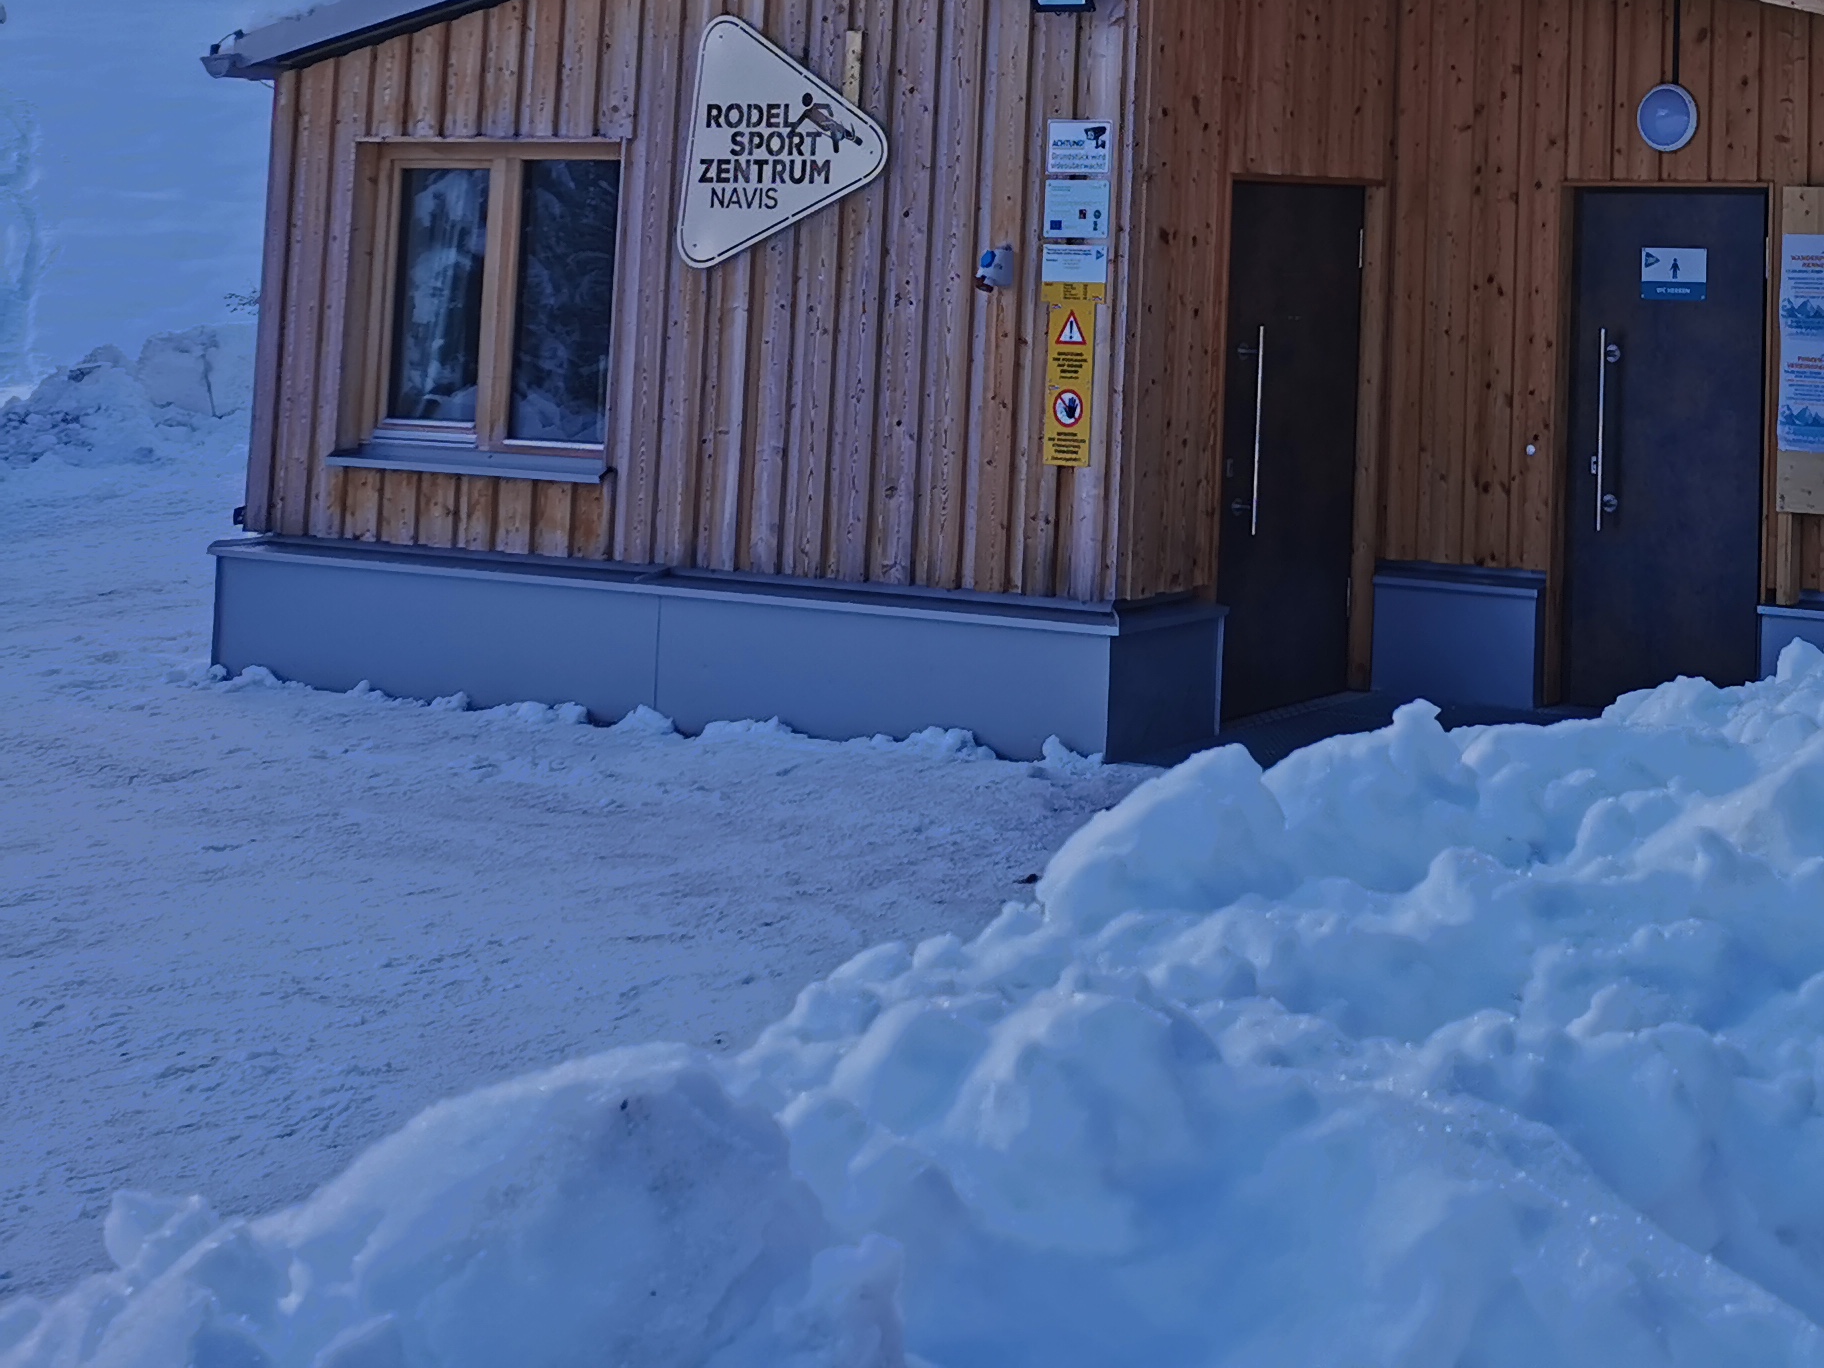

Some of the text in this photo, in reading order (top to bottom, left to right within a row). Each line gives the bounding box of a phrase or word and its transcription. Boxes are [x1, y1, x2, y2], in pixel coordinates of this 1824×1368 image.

[706, 103, 795, 129] RODEL
[730, 131, 822, 157] SPORT
[698, 158, 831, 184] ZENTRUM
[709, 187, 779, 209] NAVIS
